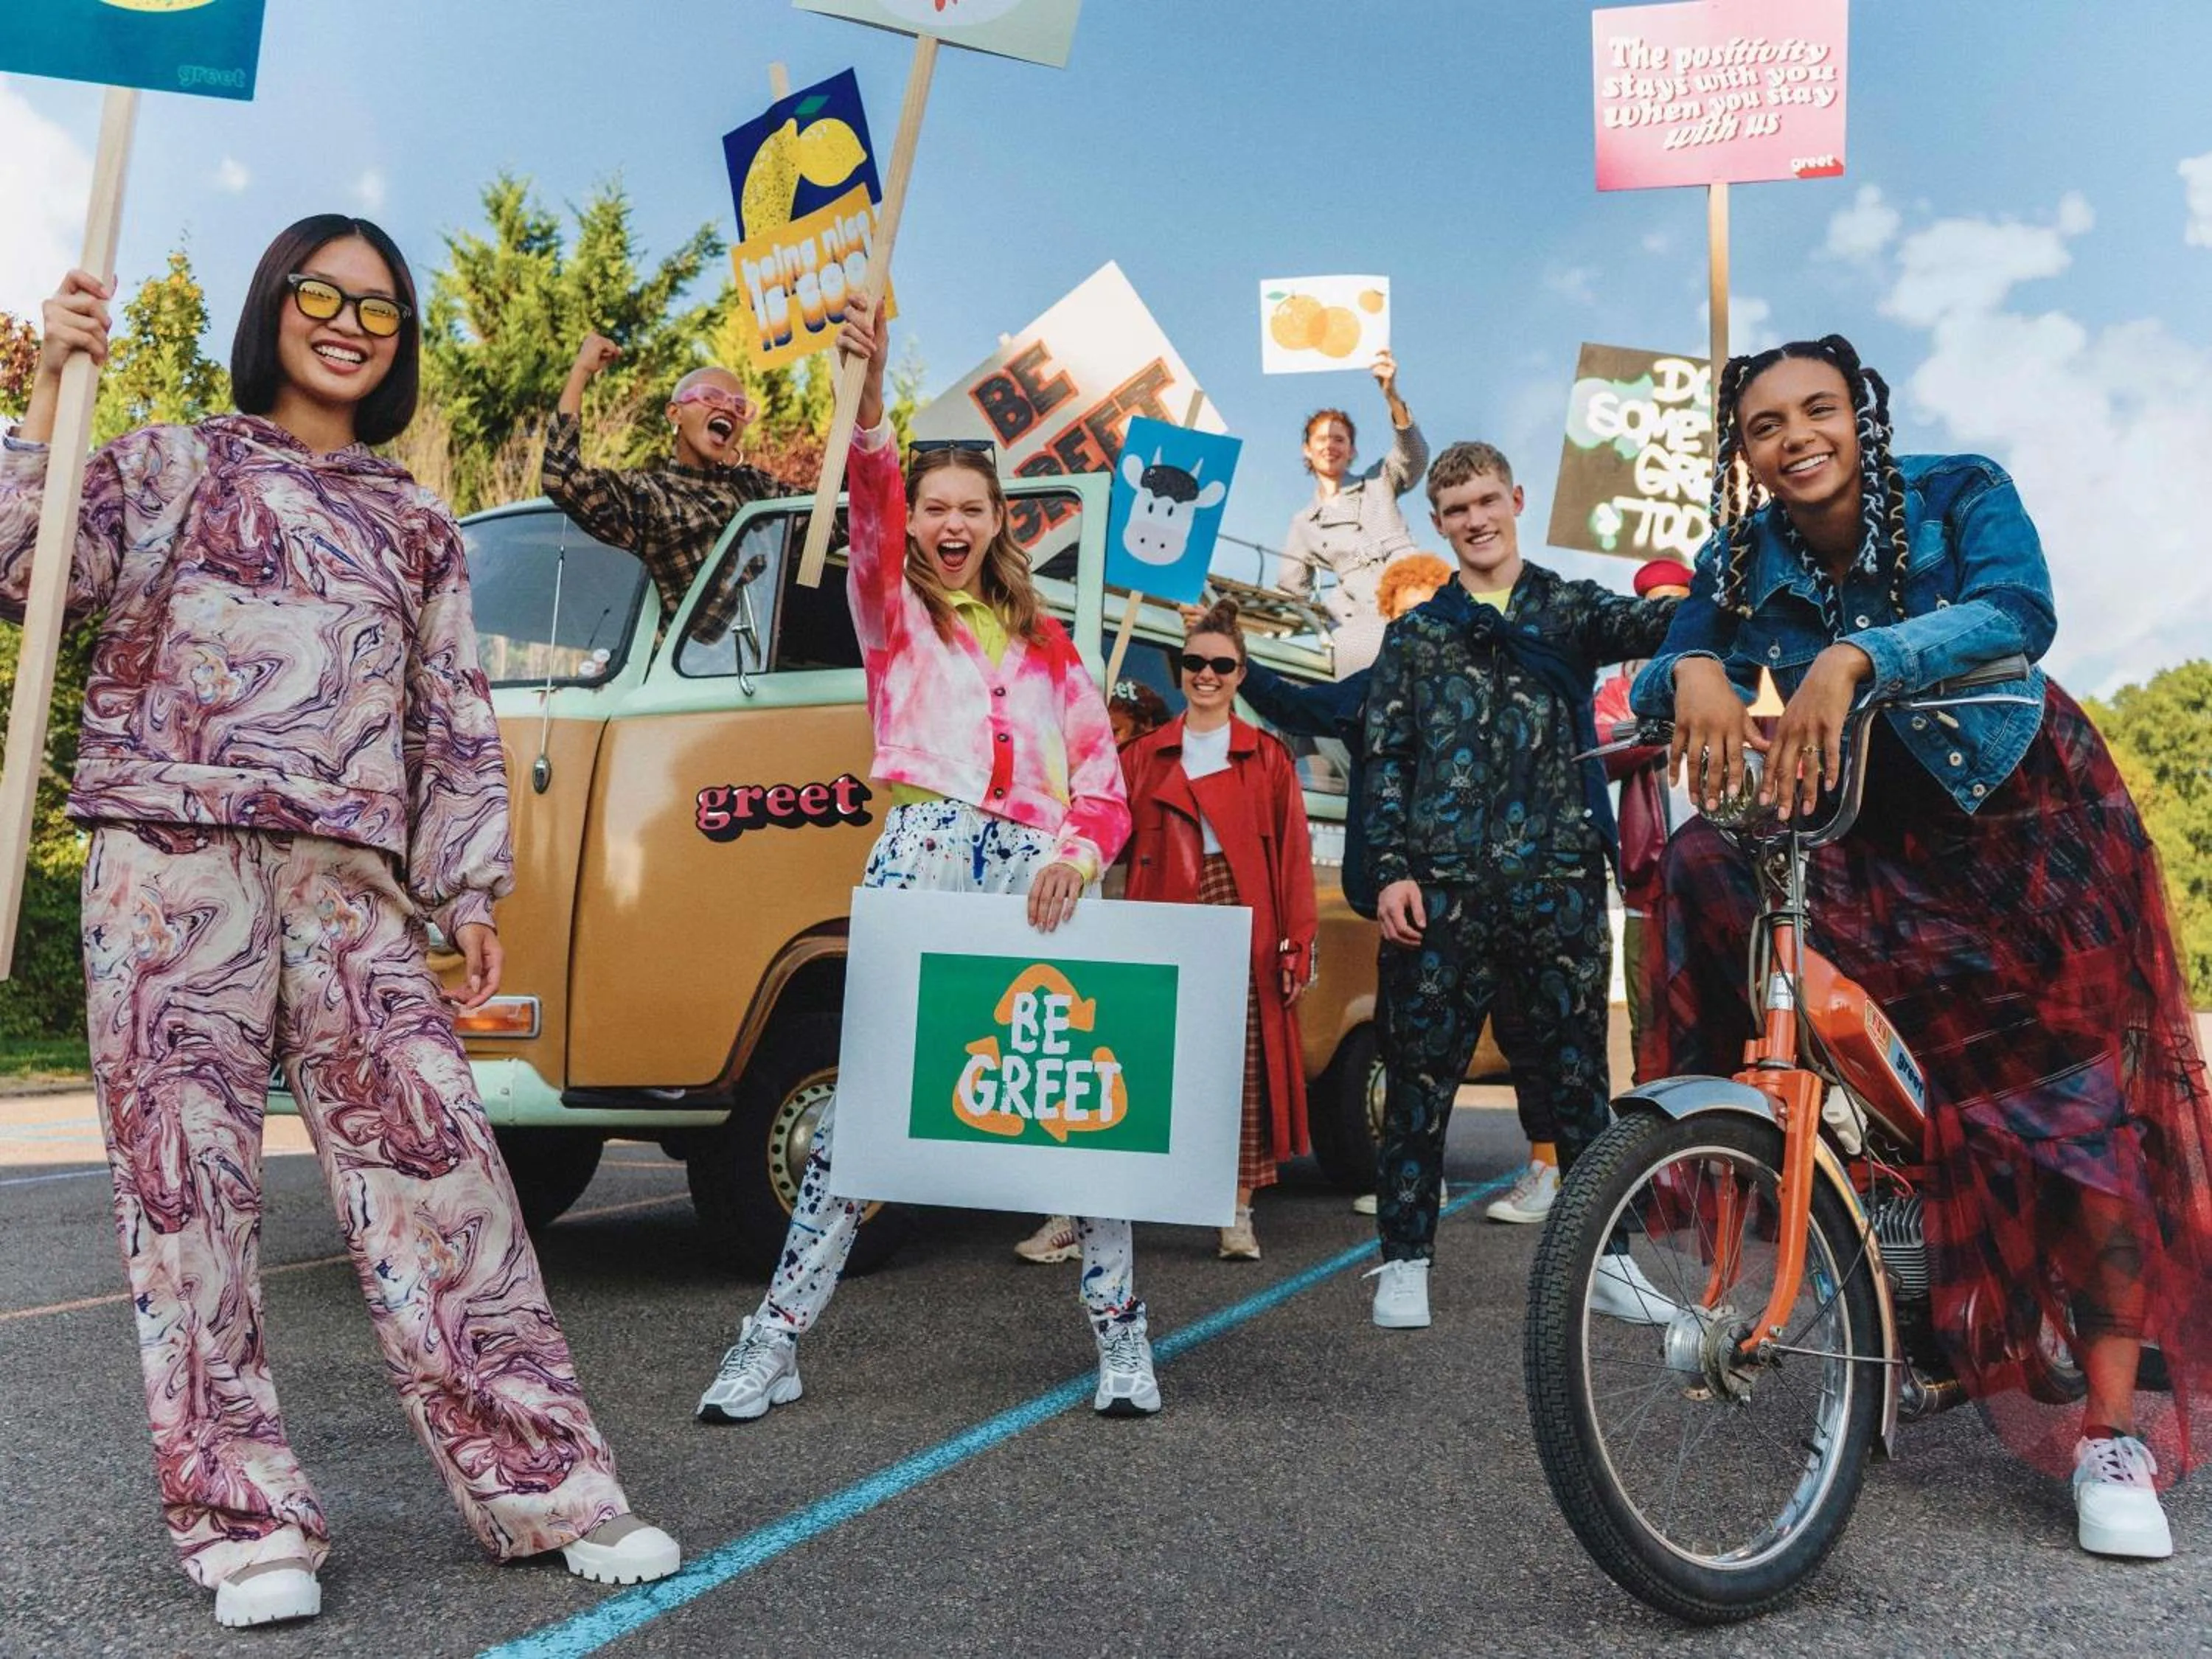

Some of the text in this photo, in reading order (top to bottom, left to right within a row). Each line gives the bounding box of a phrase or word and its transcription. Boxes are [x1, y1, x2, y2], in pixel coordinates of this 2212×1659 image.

[1609, 37, 1830, 76] The positivity
[1603, 65, 1837, 103] stays with you
[1708, 91, 1762, 118] you
[1767, 85, 1838, 109] stay
[1663, 112, 1781, 151] with us
[967, 338, 1079, 450] BE
[1113, 681, 1138, 700] et
[696, 773, 869, 838] greet
[1011, 992, 1072, 1054] BE
[959, 1054, 1122, 1123] GREET
